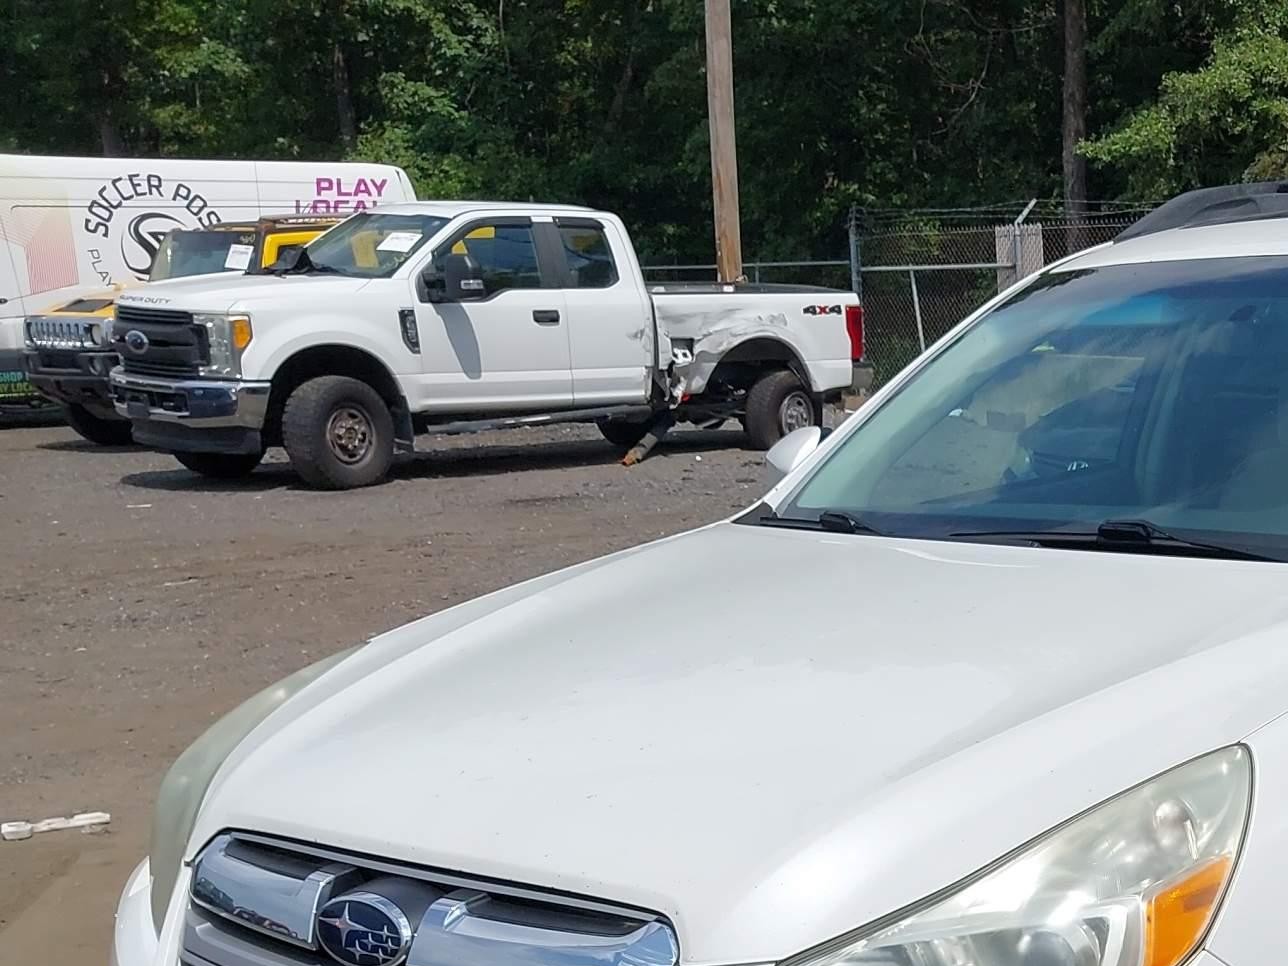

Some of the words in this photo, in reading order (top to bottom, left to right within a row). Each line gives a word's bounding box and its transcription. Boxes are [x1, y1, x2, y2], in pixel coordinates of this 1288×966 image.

[316, 177, 388, 197] PLAY
[84, 174, 164, 238] SOCCER
[295, 200, 378, 214] LOCA
[87, 249, 118, 287] PLAY
[144, 296, 171, 304] DUTY
